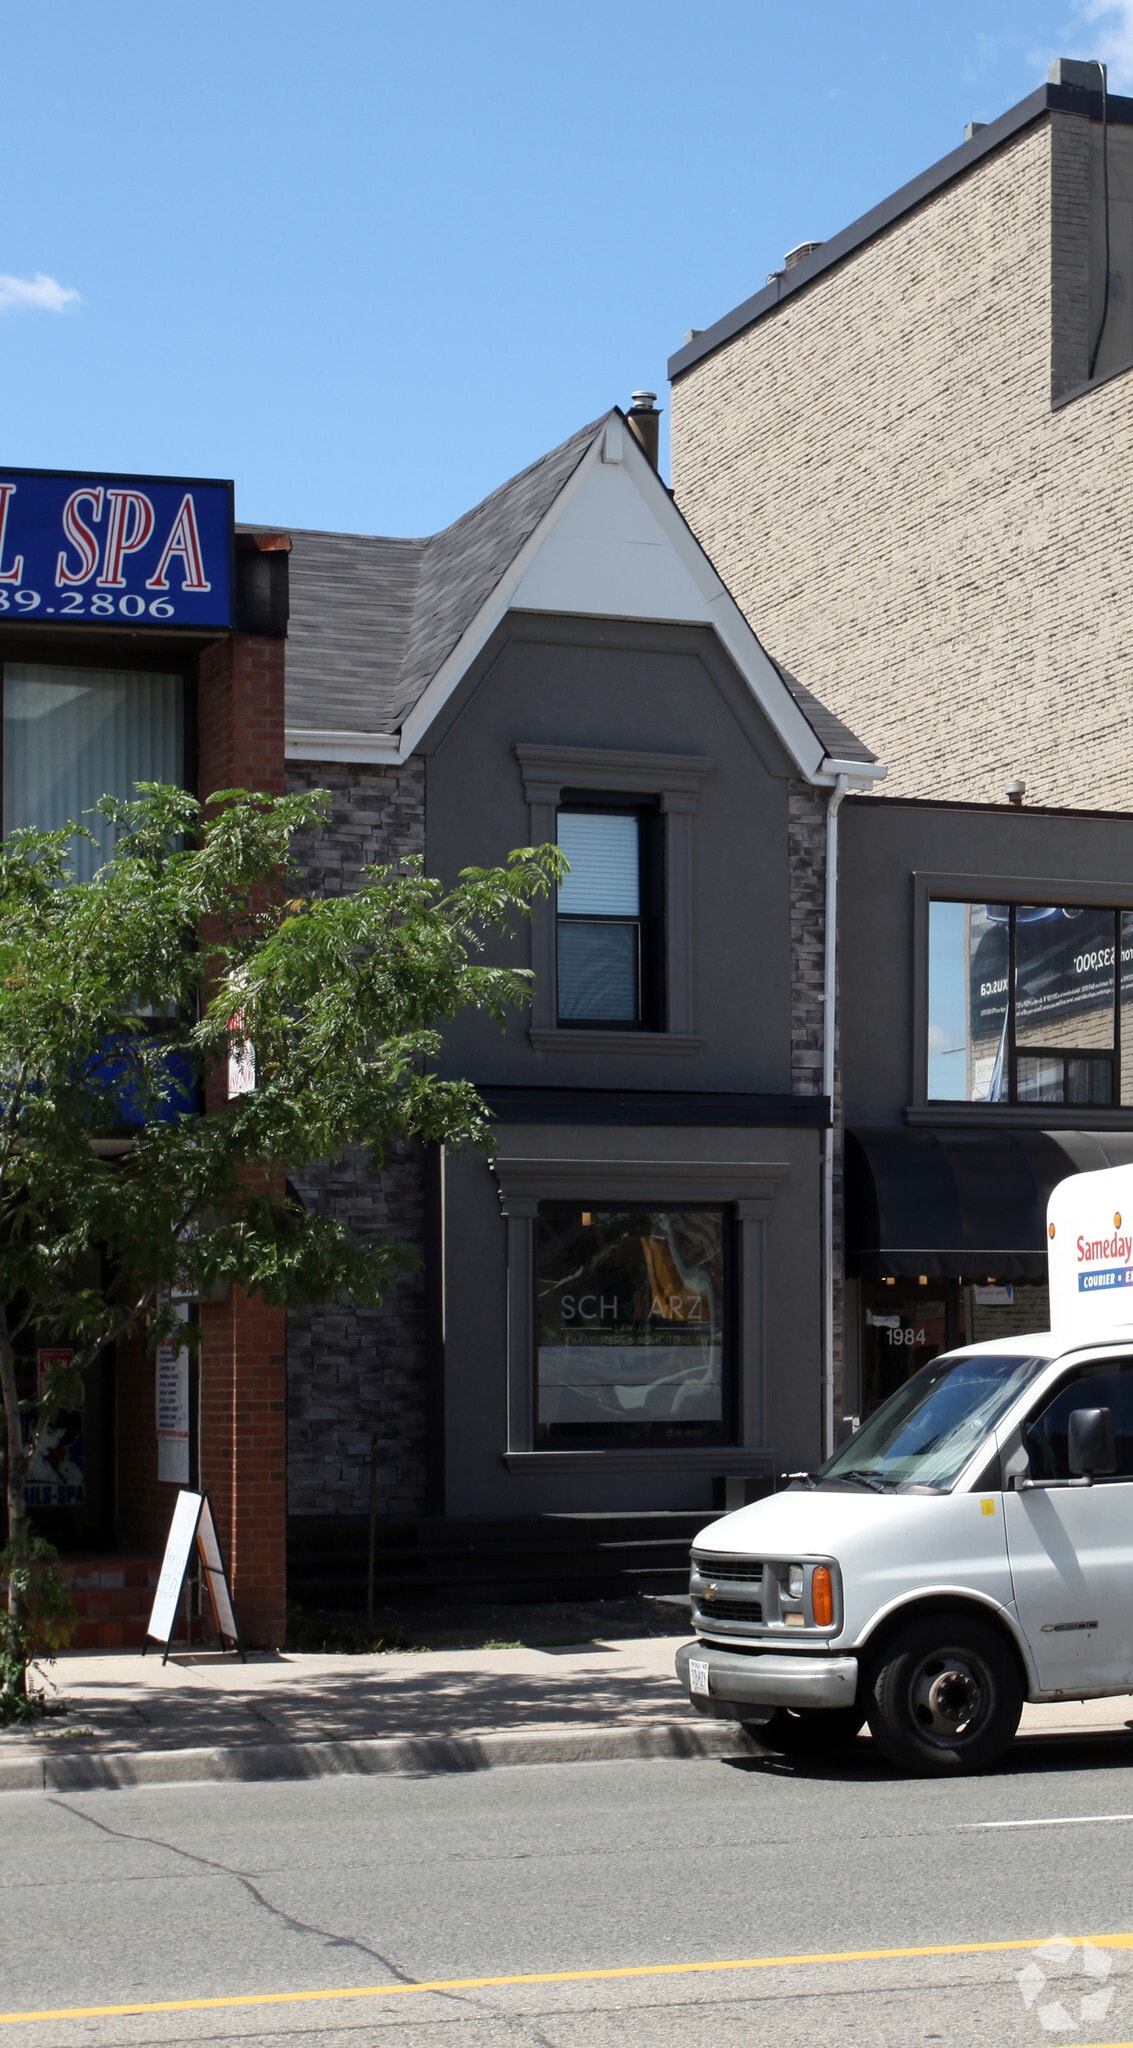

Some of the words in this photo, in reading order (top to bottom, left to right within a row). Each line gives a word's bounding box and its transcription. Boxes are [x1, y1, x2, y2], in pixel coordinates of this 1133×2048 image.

[55, 486, 211, 592] SPA
[1077, 1231, 1132, 1264] Sameday
[1084, 1273, 1116, 1289] COURIER
[561, 1295, 702, 1320] SCHARZ
[886, 1328, 926, 1346] 1984
[24, 1484, 84, 1505] AILS-SPA
